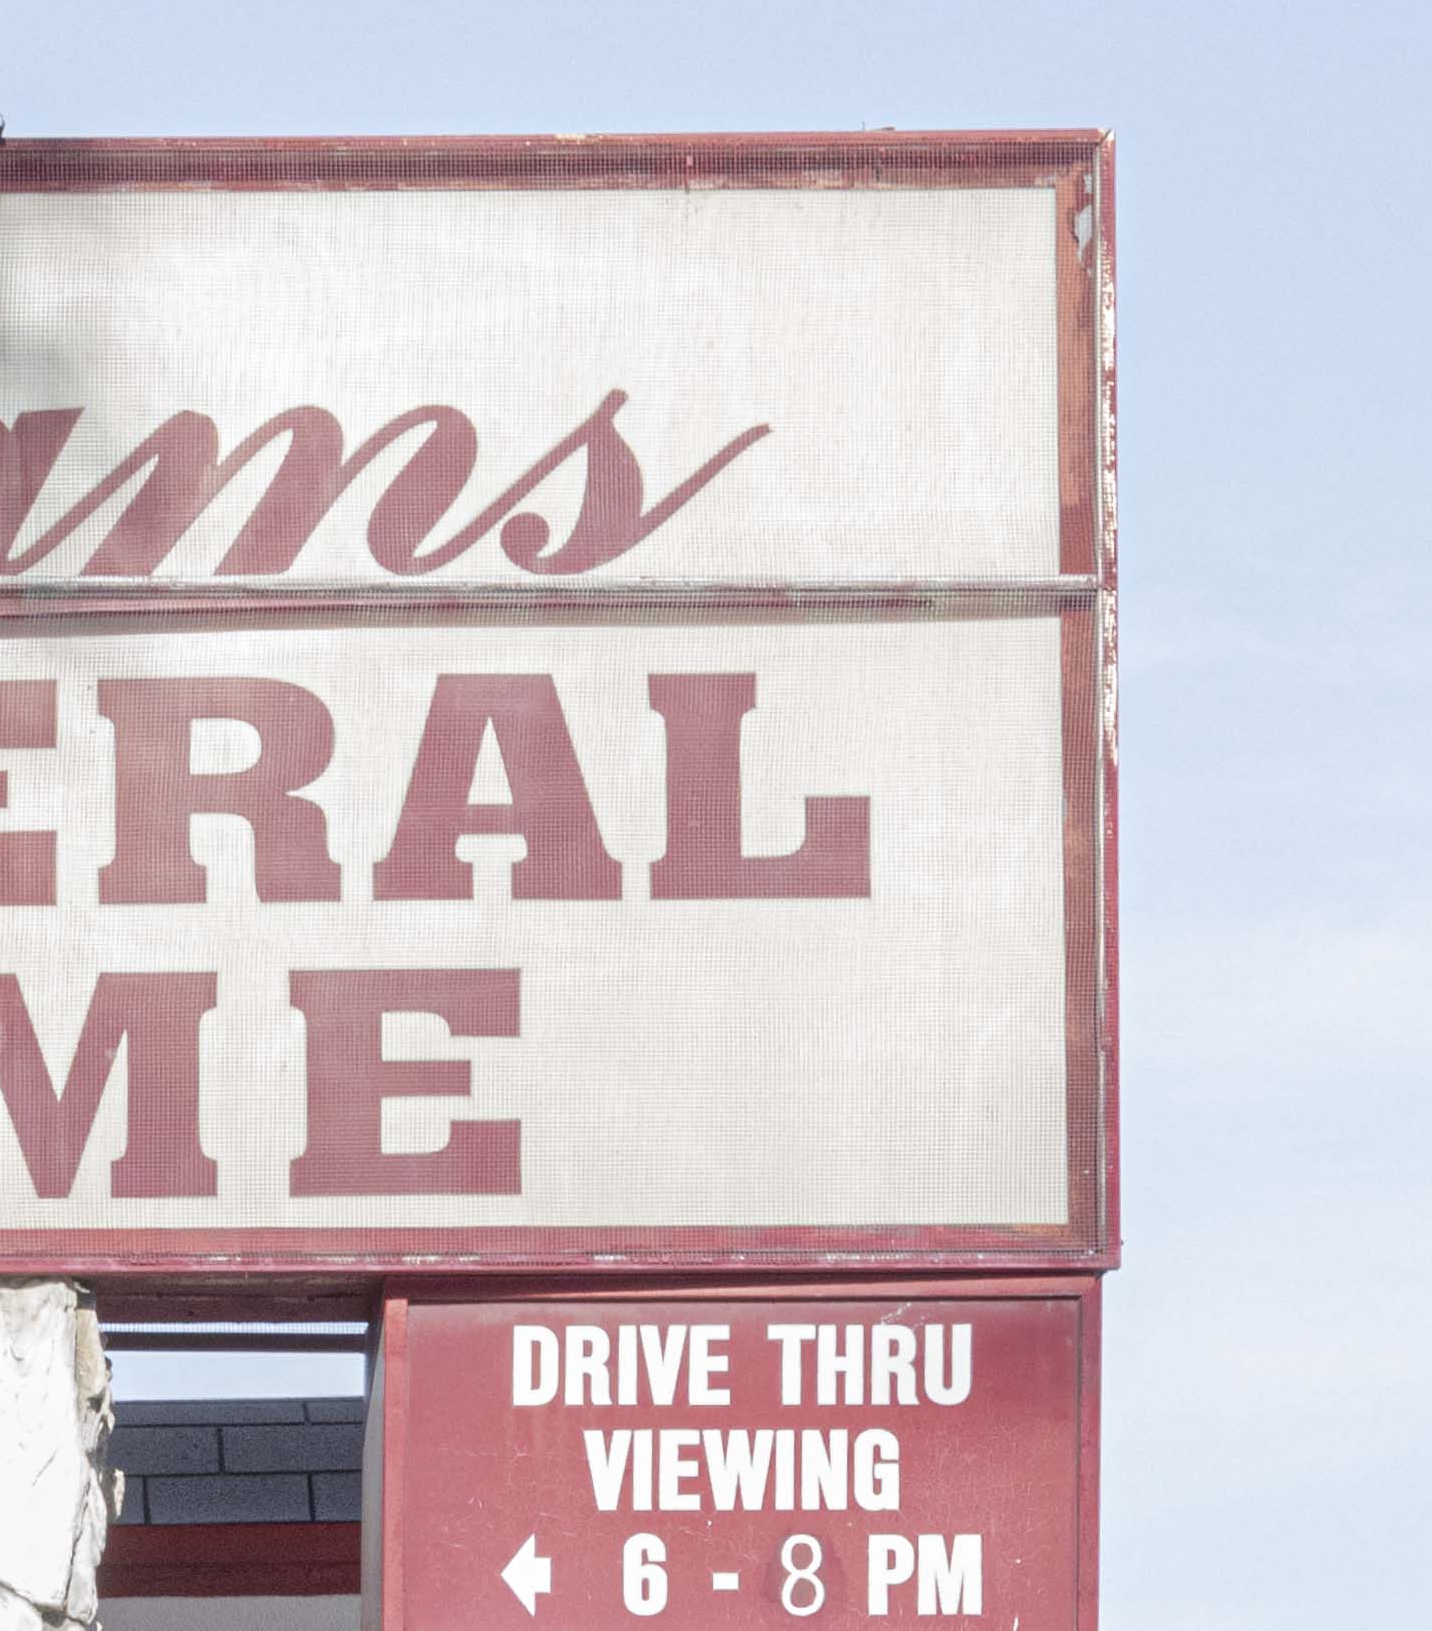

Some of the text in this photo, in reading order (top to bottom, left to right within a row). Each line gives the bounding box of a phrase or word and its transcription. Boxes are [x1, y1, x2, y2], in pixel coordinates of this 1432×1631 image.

[511, 1323, 974, 1407] DRIVE THRU
[583, 1428, 901, 1512] VIEWING
[621, 1532, 983, 1617] 6 - 8 PM
